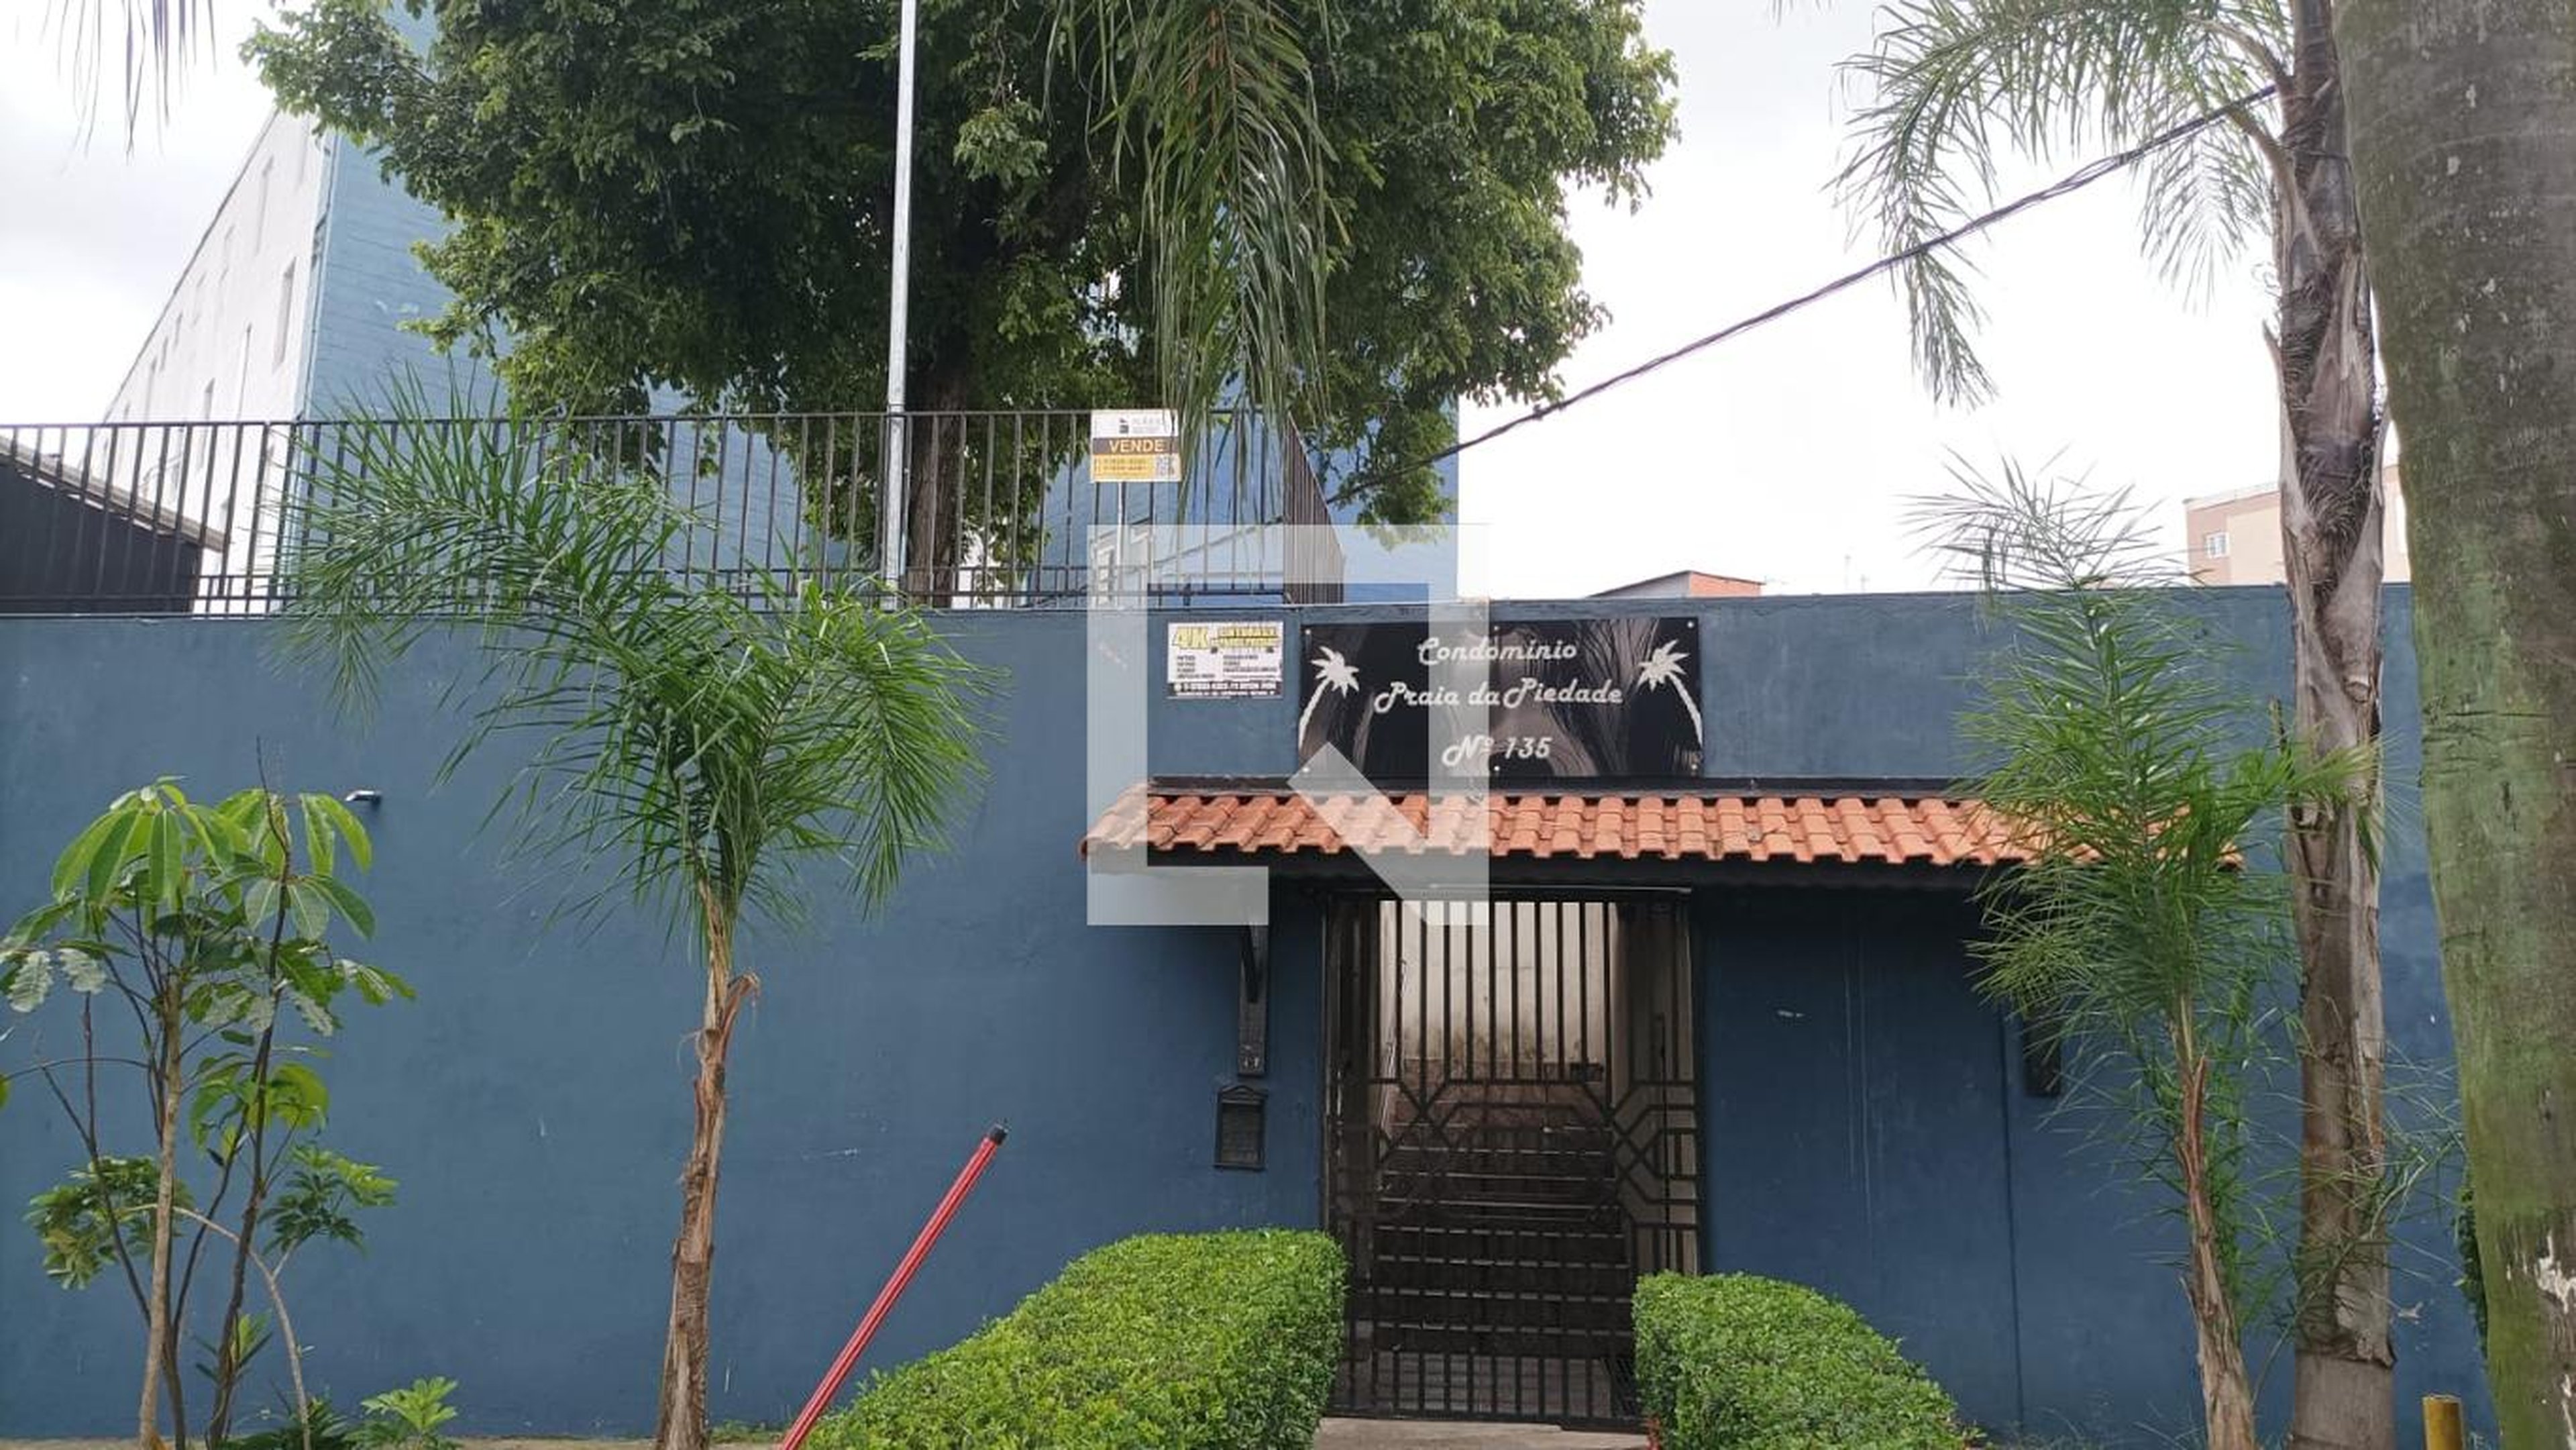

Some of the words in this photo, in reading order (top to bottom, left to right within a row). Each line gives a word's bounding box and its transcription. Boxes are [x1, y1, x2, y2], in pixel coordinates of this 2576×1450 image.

[1109, 439, 1164, 453] VENDE
[1375, 681, 1460, 713] Praia
[1468, 681, 1501, 706] da
[1503, 677, 1623, 709] Piedade
[1505, 737, 1552, 760] 135
